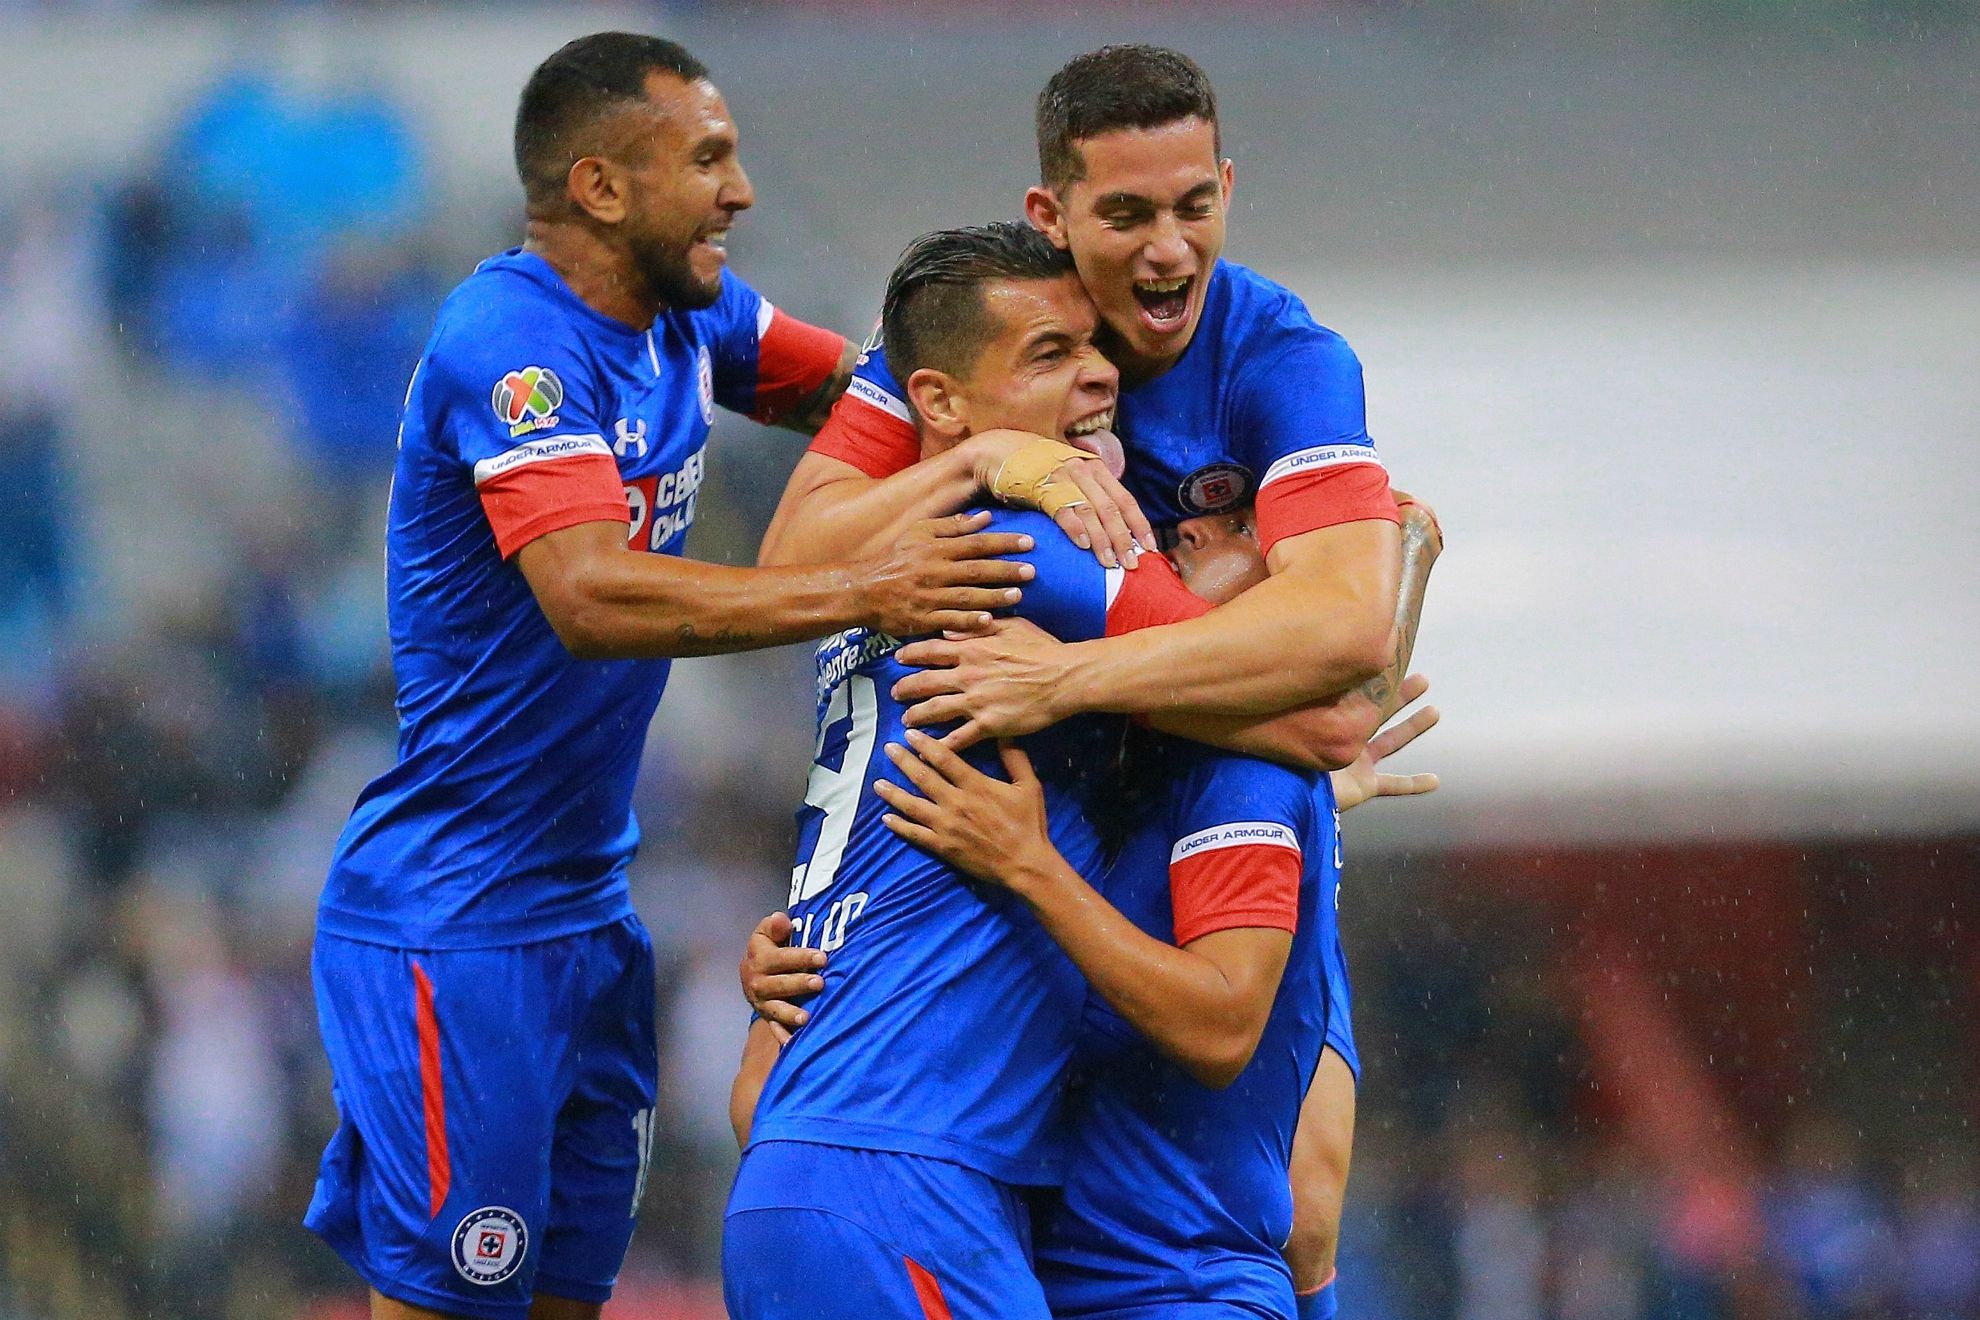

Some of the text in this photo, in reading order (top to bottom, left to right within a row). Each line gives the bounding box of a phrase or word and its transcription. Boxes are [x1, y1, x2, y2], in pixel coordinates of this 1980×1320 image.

[491, 440, 592, 470] UNDER ARMOUR
[1290, 451, 1337, 467] UNDER
[1180, 828, 1283, 853] UNDER ARMOUR
